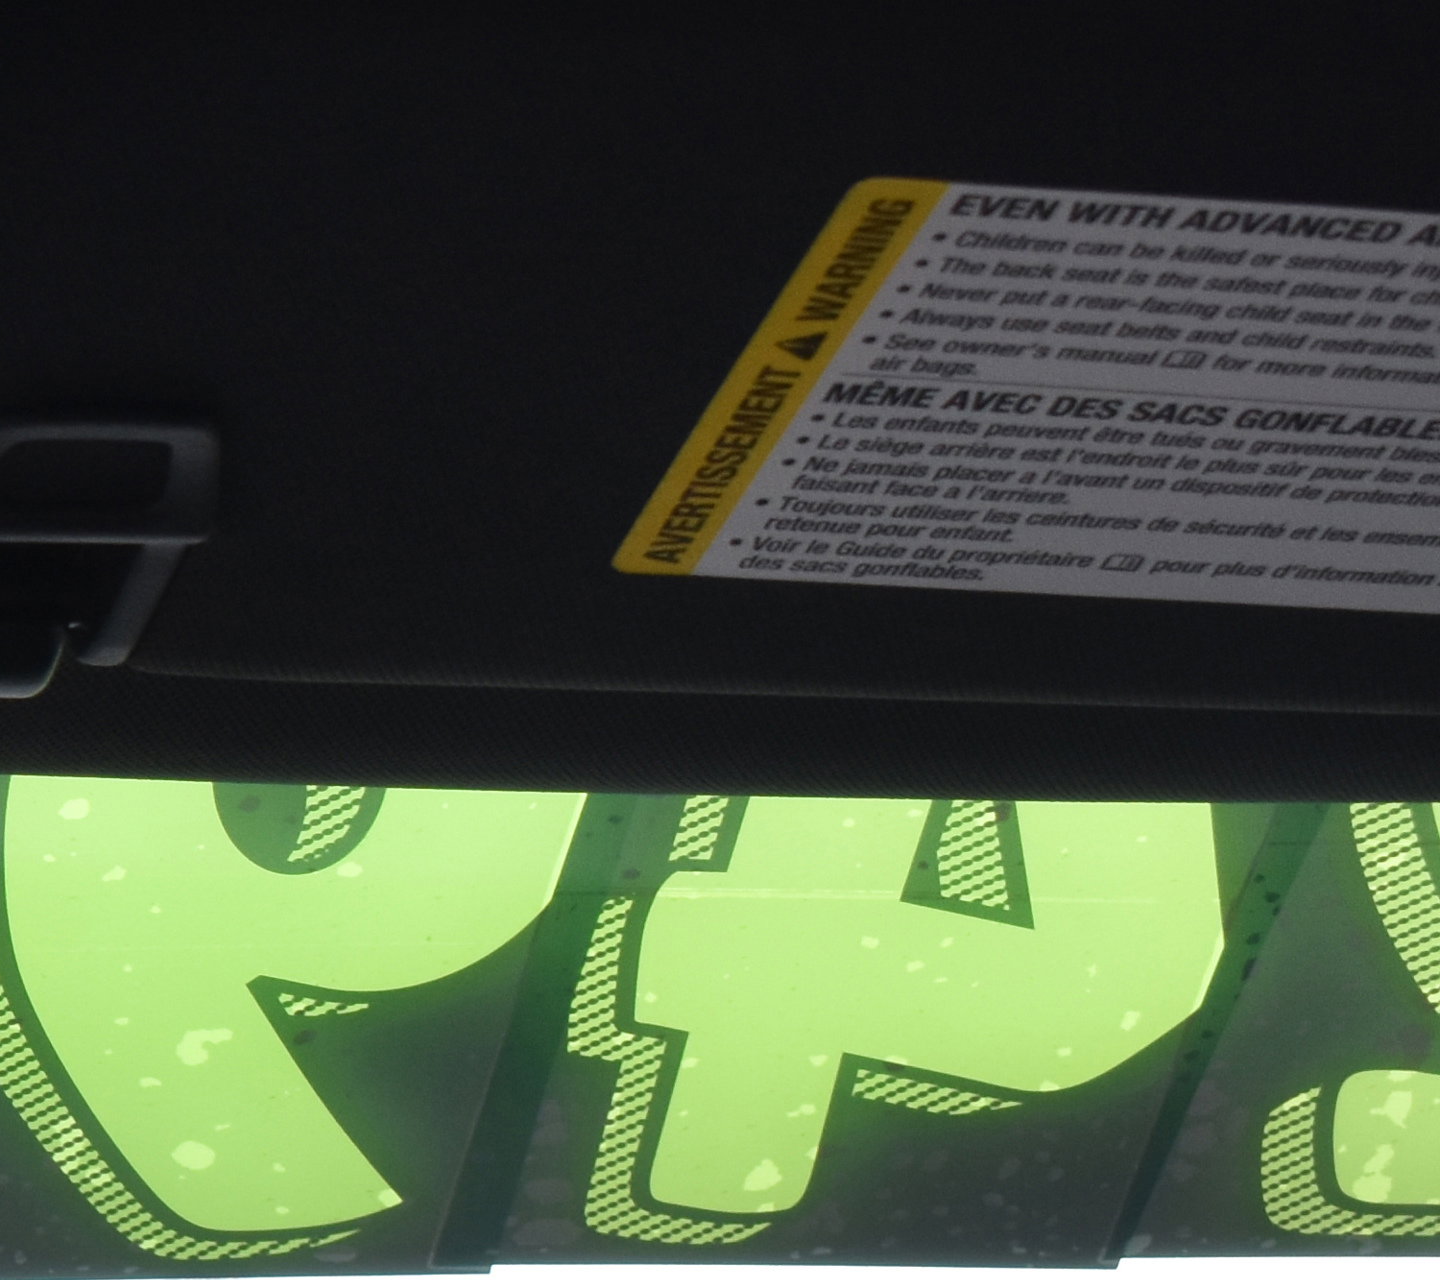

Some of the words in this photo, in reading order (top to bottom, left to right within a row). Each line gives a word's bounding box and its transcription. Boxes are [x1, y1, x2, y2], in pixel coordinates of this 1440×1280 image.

[950, 194, 1061, 222] EVEN
[1068, 201, 1176, 229] WITH
[1176, 208, 1403, 243] ADVANCED
[954, 230, 1069, 253] Children
[1072, 241, 1126, 257] can
[1128, 242, 1167, 260] be
[1169, 244, 1249, 266] killed
[1249, 253, 1282, 267] or
[1283, 255, 1410, 278] seriously
[940, 256, 988, 276] The
[991, 260, 1058, 280] back
[1060, 267, 1124, 284] seat
[1123, 268, 1151, 287] is
[1154, 271, 1201, 289] the
[1202, 276, 1288, 295] safest
[1286, 282, 1364, 301] place
[1366, 284, 1408, 303] for
[899, 308, 997, 332] Always
[1000, 317, 1051, 333] use
[1052, 320, 1115, 337] seat
[1115, 321, 1183, 342] belts
[1185, 328, 1240, 346] and
[1241, 331, 1310, 350] child
[918, 282, 999, 303] Never
[998, 290, 1050, 306] put
[1072, 295, 1223, 321] rear-facing
[1225, 303, 1294, 323] child
[1293, 310, 1356, 327] seat
[1355, 312, 1385, 329] in
[1388, 314, 1433, 332] the
[869, 355, 908, 372] air
[884, 333, 938, 352] See
[1055, 346, 1161, 366] manual
[1211, 353, 1254, 372] for
[1254, 359, 1328, 377] more
[644, 365, 801, 565] AVERTISSEMENT
[794, 198, 915, 322] WARNING
[822, 379, 941, 409] MÊME
[939, 389, 1045, 415] AVEC
[1046, 395, 1124, 420] DES
[1126, 401, 1230, 427] SACS
[816, 433, 852, 451] Le
[1019, 447, 1065, 463] est
[1173, 454, 1201, 471] le
[1201, 457, 1262, 475] plus
[1307, 466, 1374, 482] pour
[1373, 467, 1415, 484] les
[831, 411, 880, 430] Les
[883, 416, 981, 436] enfants
[982, 422, 1092, 442] peuvent
[1210, 437, 1246, 452] ou
[1246, 439, 1389, 460] gravement
[791, 474, 881, 495] faisant
[883, 480, 940, 498] face
[802, 455, 841, 474] Ne
[840, 458, 930, 478] jamais
[931, 464, 1017, 483] placer
[1131, 477, 1167, 491] un
[1169, 477, 1292, 498] dispositif
[1289, 484, 1324, 501] de
[763, 515, 863, 535] retenue
[863, 523, 929, 538] pour
[779, 495, 888, 518] Toujours
[889, 504, 980, 522] utiliser
[981, 508, 1022, 525] les
[1025, 511, 1144, 531] ceintures
[1146, 516, 1181, 533] de
[1288, 525, 1320, 541] et
[1318, 526, 1360, 543] les
[738, 554, 786, 571] des
[788, 559, 849, 574] sacs
[752, 535, 803, 554] Voir
[804, 539, 831, 555] le
[835, 540, 909, 559] Guide
[911, 544, 947, 561] du
[1148, 559, 1212, 575] pour
[1210, 561, 1269, 578] plus
